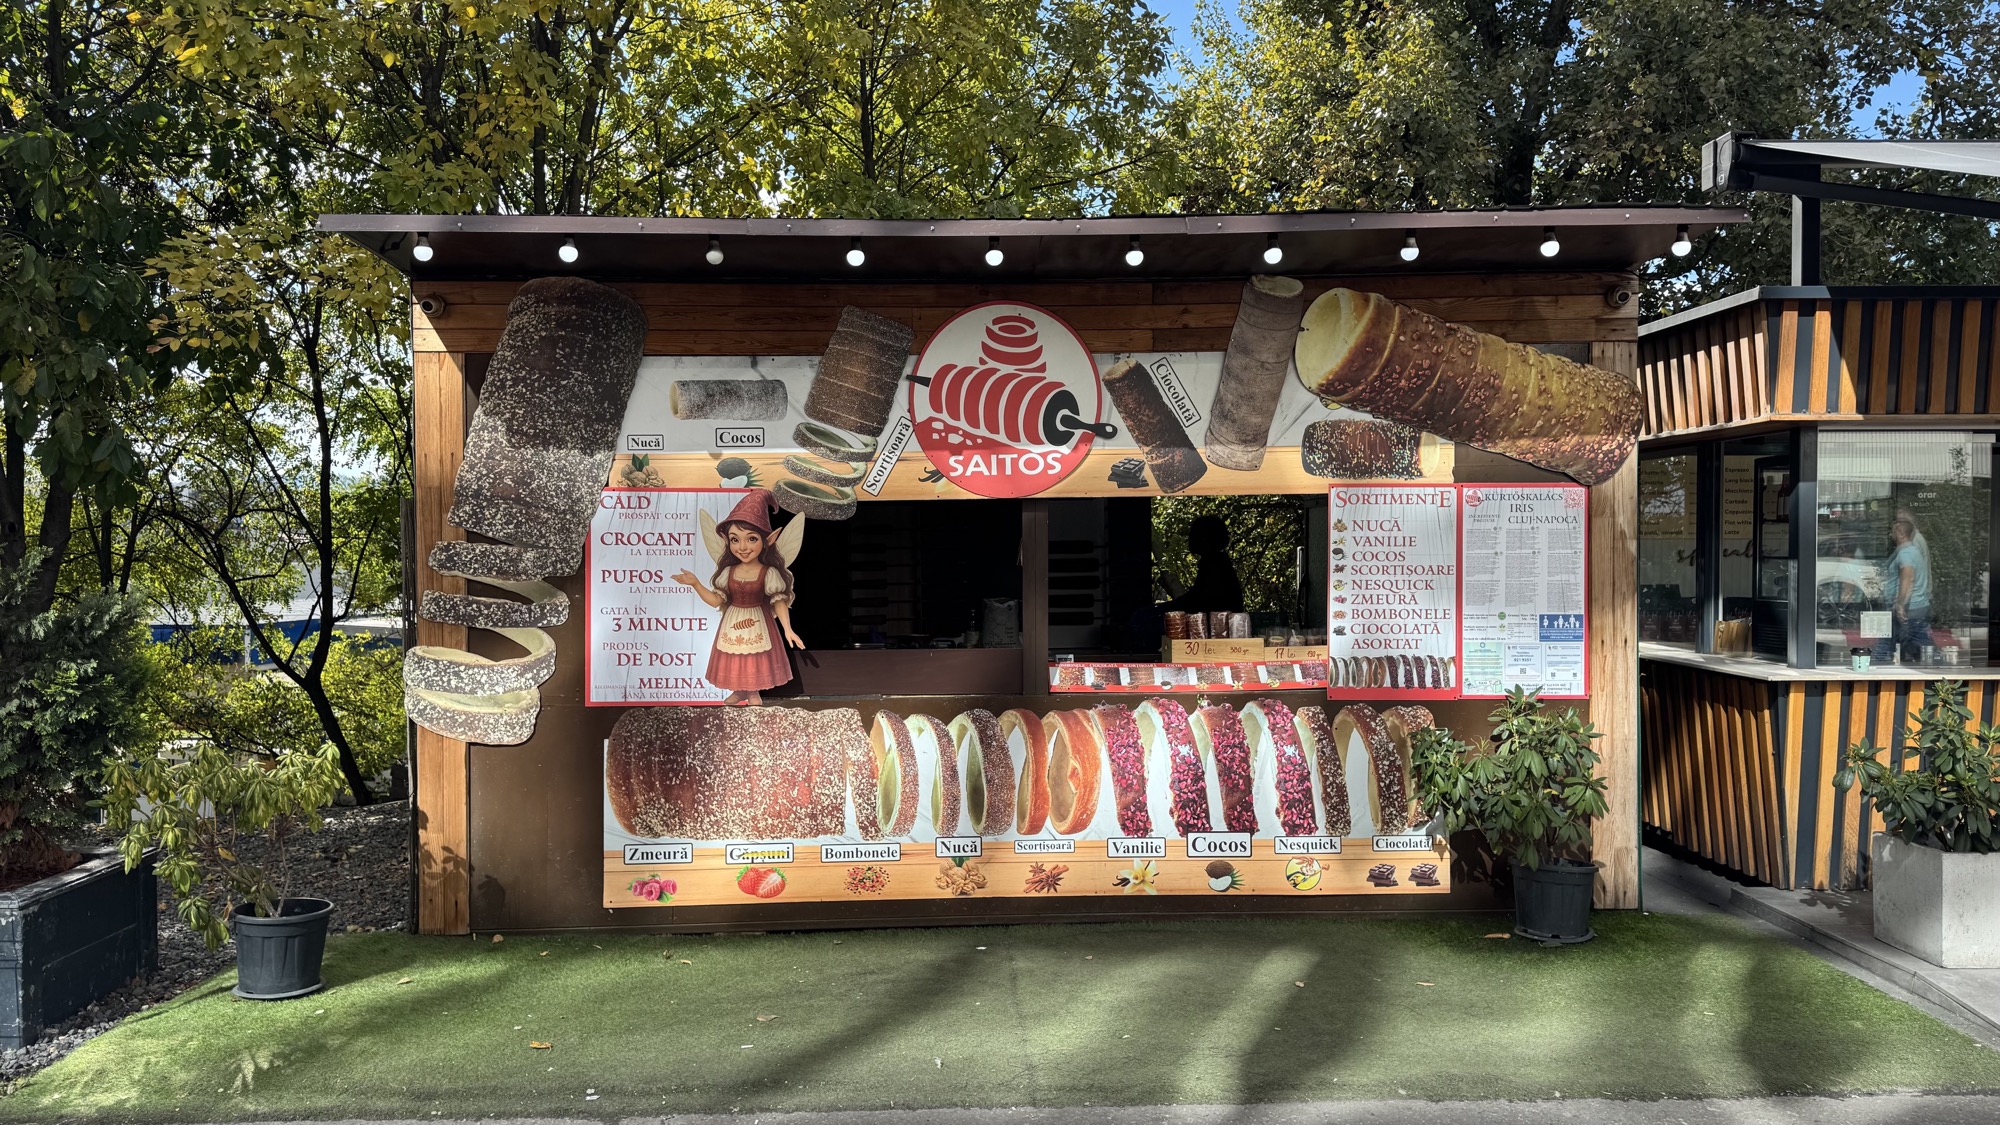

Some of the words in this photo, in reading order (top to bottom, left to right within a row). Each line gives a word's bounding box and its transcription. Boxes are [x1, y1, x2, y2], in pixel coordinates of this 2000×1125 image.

[1156, 363, 1197, 423] Ciocolată
[630, 437, 661, 449] Nucă
[719, 431, 762, 445] Cocos
[866, 421, 911, 491] Scorțișoară
[948, 452, 1063, 477] SAITOS
[600, 495, 651, 510] CALD
[1335, 490, 1452, 508] SORTIMENTE
[1485, 491, 1563, 501] KÜRTŐSKALÁCS
[1509, 503, 1534, 513] IRIS
[665, 512, 691, 520] COPT
[1508, 515, 1579, 525] CLUJ-NAPOCA
[1352, 516, 1402, 532] NUCĂ
[600, 532, 695, 546] CROCANT
[1352, 536, 1417, 547] VANILIE
[1352, 551, 1406, 562] COCOS
[600, 569, 664, 584] PUFOS
[1350, 564, 1455, 578] SCORȚIȘOARE
[630, 586, 641, 594] LA
[645, 586, 693, 594] INTERIOR
[1351, 579, 1435, 594] NESQUICK
[1350, 591, 1419, 605] ZMEURĂ
[600, 607, 629, 615] GATA
[634, 604, 647, 615] ÎN
[1351, 608, 1451, 620] BOMBONELE
[612, 618, 622, 632] 3
[628, 618, 708, 632] MINUTE
[1350, 621, 1441, 635] CIOCOLATĂ
[602, 642, 649, 651] PRODUS
[1185, 641, 1199, 656] 30
[1204, 641, 1216, 655] lei
[1351, 638, 1423, 650] ASORTAT
[616, 653, 643, 667] DE
[648, 653, 697, 667] POST
[1274, 648, 1284, 659] 17
[1287, 648, 1296, 658] lei
[638, 678, 705, 690] MELINA
[939, 840, 979, 854] Nucă
[1017, 841, 1072, 852] Scorțișoară
[1112, 840, 1163, 855] Vanilie
[1191, 836, 1248, 853] Cocos
[1278, 837, 1337, 854] Nesquick
[1375, 837, 1430, 849] Ciocolată
[628, 847, 689, 862] Zmeură
[824, 847, 898, 861] Bombonele
